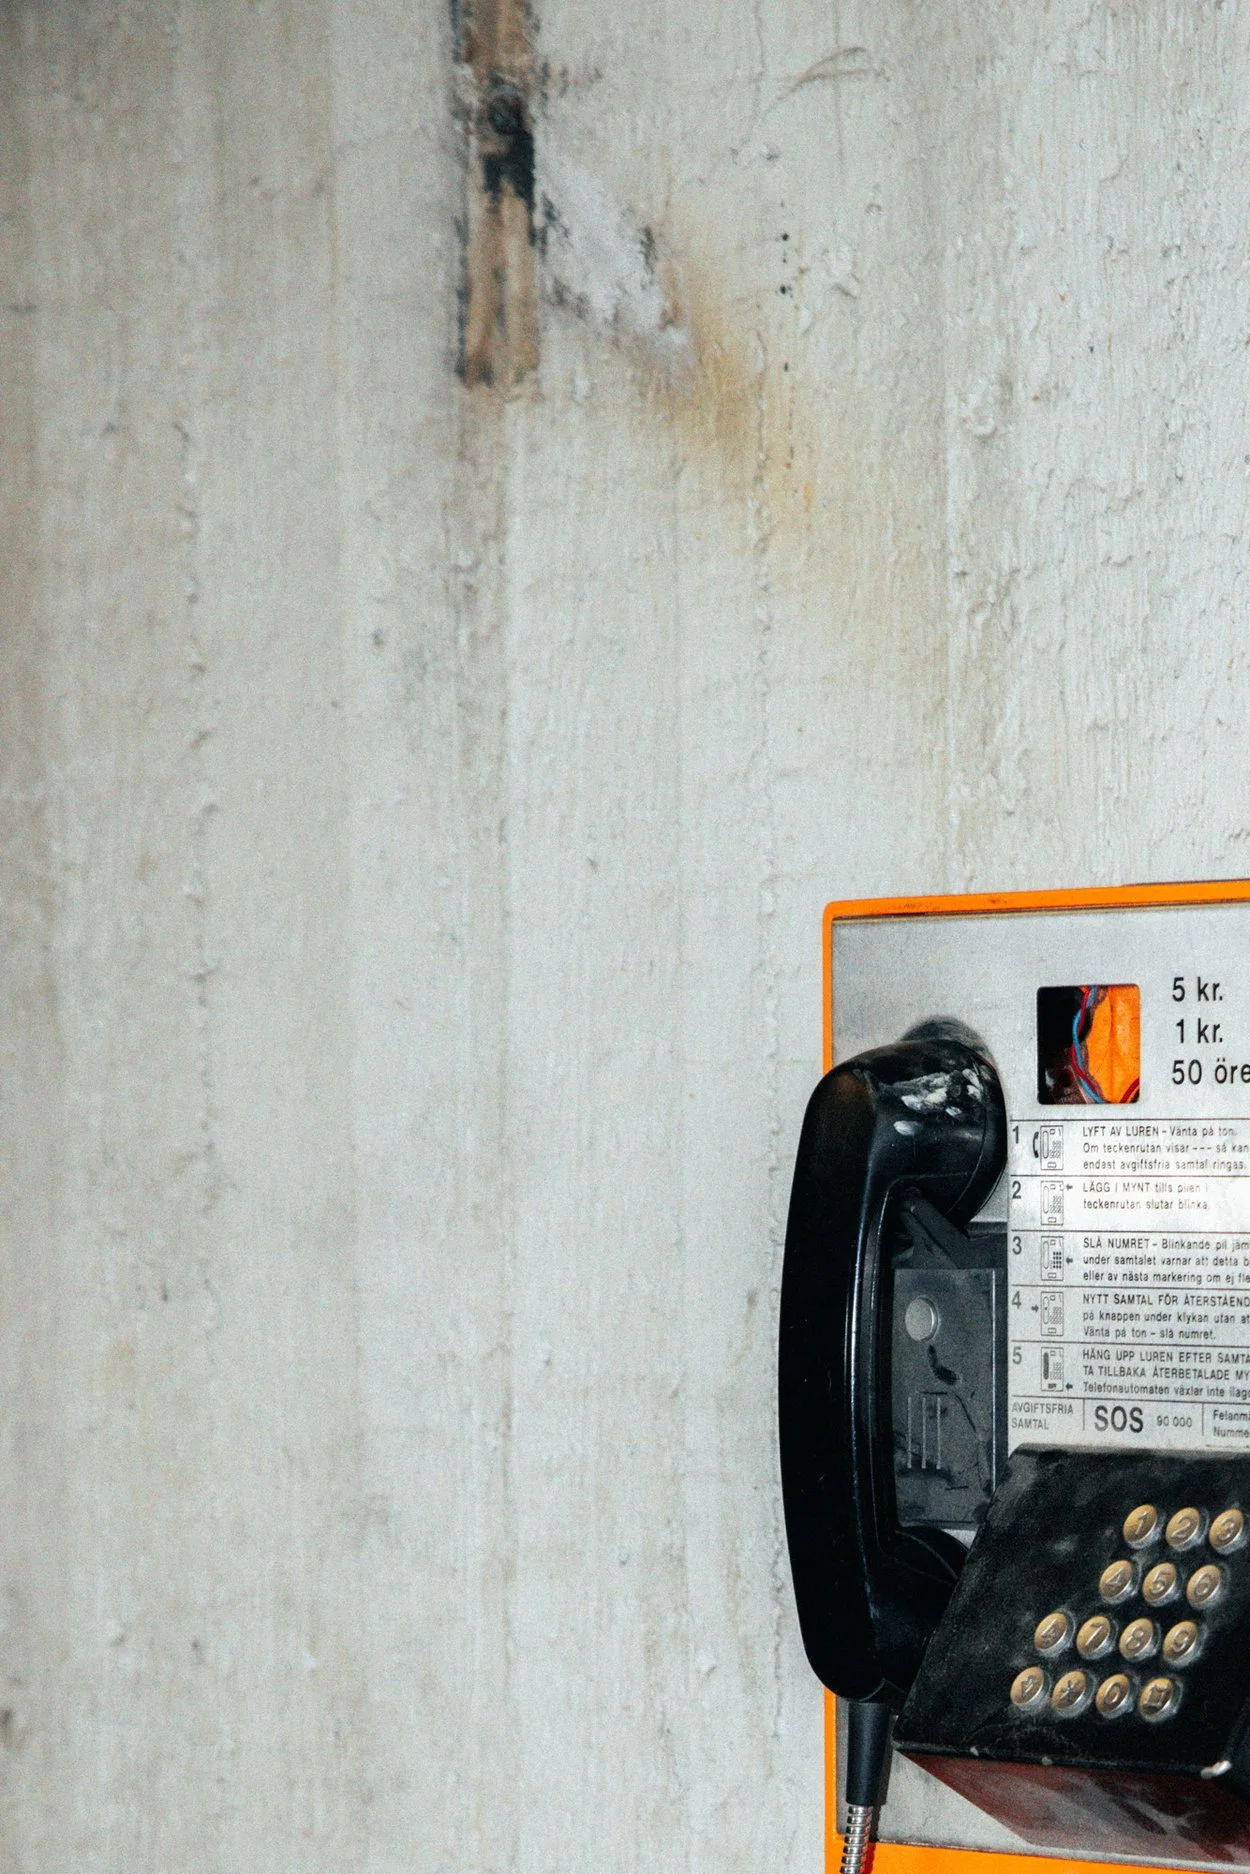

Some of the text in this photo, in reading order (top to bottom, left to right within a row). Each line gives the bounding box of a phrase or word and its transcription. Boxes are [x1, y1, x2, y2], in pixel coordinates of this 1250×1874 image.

[1172, 976, 1223, 1002] 5 kr.
[1176, 1017, 1223, 1043] 1 kr.
[1172, 1059, 1202, 1085] 50
[1013, 1126, 1019, 1144] 1
[1082, 1126, 1106, 1137] LYFT
[1110, 1126, 1122, 1137] AV
[1126, 1126, 1159, 1137] LUREN
[1170, 1126, 1198, 1137] Vänta
[1083, 1143, 1099, 1153] Om
[1103, 1142, 1161, 1153] teckenrutan
[1166, 1142, 1189, 1153] visar
[1231, 1142, 1249, 1153] kan
[1083, 1159, 1116, 1170] endast
[1120, 1159, 1170, 1172] avgiftsfria
[1176, 1159, 1208, 1170] samtal
[1012, 1181, 1022, 1199] 2
[1082, 1180, 1111, 1193] LÄGG
[1122, 1182, 1150, 1193] MYNT
[1155, 1182, 1173, 1193] tills
[1083, 1199, 1141, 1210] teckenrutan
[1146, 1199, 1174, 1210] slutar
[1013, 1236, 1022, 1255] 3
[1083, 1236, 1102, 1249] SLÅ
[1108, 1238, 1150, 1249] NUMRET
[1161, 1238, 1210, 1250] Blinkande
[1083, 1255, 1110, 1265] under
[1114, 1255, 1157, 1266] samtalet
[1161, 1256, 1191, 1266] varnar
[1195, 1256, 1209, 1266] att
[1213, 1256, 1239, 1267] detta
[1083, 1270, 1104, 1281] eller
[1107, 1272, 1118, 1281] av
[1122, 1271, 1149, 1282] nästa
[1153, 1271, 1202, 1285] markering
[1206, 1274, 1221, 1283] om
[1012, 1291, 1022, 1310] 4
[1083, 1293, 1109, 1305] NYTT
[1113, 1293, 1153, 1306] SAMTAL
[1158, 1293, 1178, 1306] FÖR
[1099, 1310, 1141, 1323] knappen
[1144, 1311, 1172, 1322] under
[1177, 1311, 1209, 1324] klykan
[1213, 1314, 1236, 1324] utan
[1083, 1325, 1110, 1338] Vänta
[1115, 1327, 1127, 1340] på
[1131, 1328, 1147, 1338] ton
[1159, 1328, 1174, 1339] slå
[1178, 1329, 1216, 1340] numret.
[1012, 1346, 1022, 1365] 5
[1082, 1347, 1111, 1361] HÄNG
[1116, 1350, 1135, 1361] UPP
[1140, 1351, 1173, 1362] LUREN
[1178, 1351, 1212, 1363] EFTER
[1083, 1365, 1094, 1376] TA
[1098, 1366, 1146, 1378] TILLBAKA
[1152, 1365, 1230, 1380] ÅTERBETALADE
[1083, 1381, 1170, 1395] Telefonautomaten
[1174, 1386, 1204, 1396] växlar
[1207, 1386, 1225, 1397] inte
[1011, 1402, 1073, 1415] AVGIFTSFRIA
[1011, 1417, 1049, 1430] SAMTAL
[1094, 1405, 1144, 1434] SOS
[1156, 1416, 1193, 1428] 90 000
[1134, 1511, 1235, 1540] 1 2 3
[1106, 1567, 1214, 1596] 4 5 6
[1085, 1622, 1104, 1646] 7
[1126, 1627, 1145, 1650] 8
[1173, 1630, 1190, 1652] 9
[1104, 1682, 1121, 1705] 0
